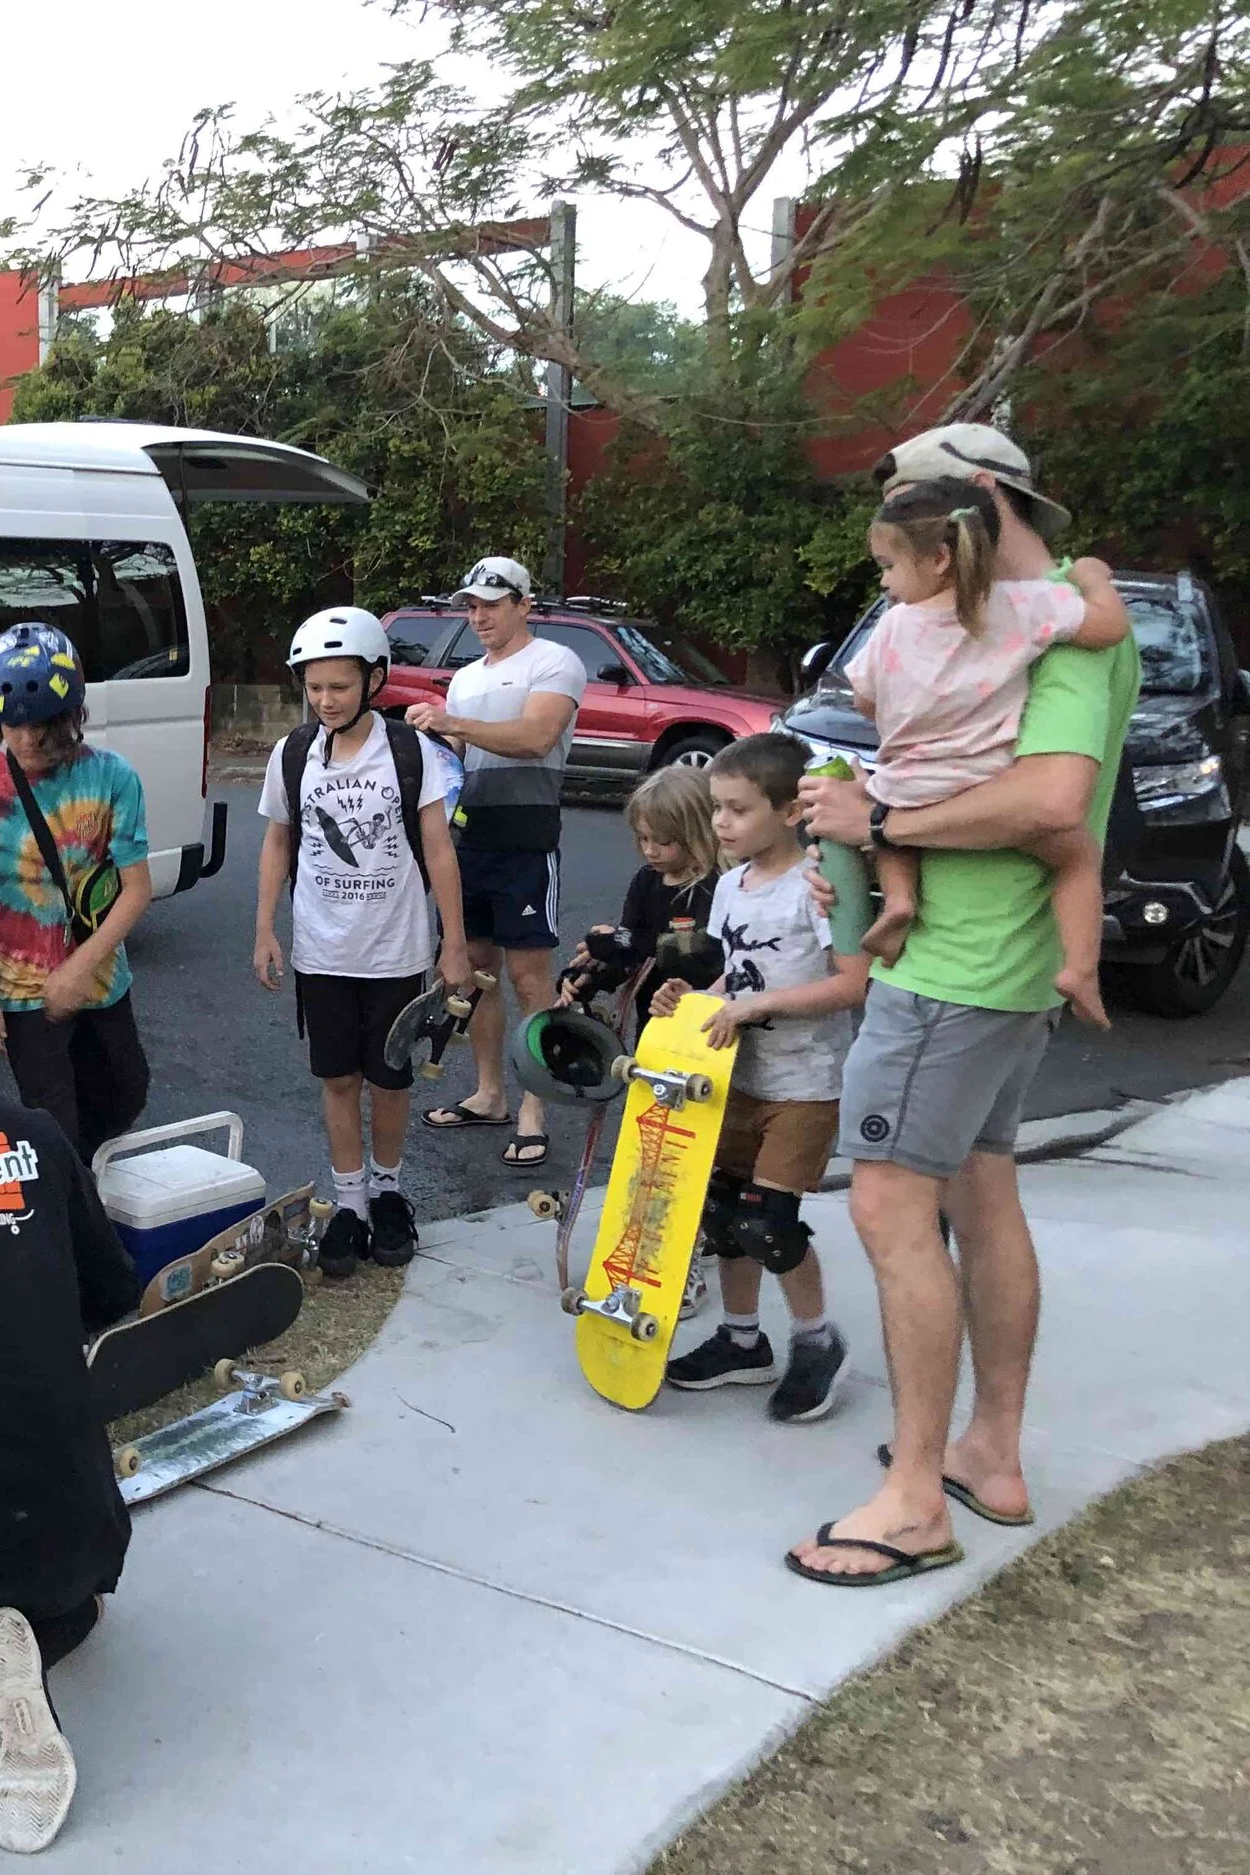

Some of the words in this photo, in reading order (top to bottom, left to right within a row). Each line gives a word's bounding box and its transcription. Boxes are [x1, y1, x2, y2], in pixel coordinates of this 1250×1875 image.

[304, 778, 377, 826] STRALIAN
[315, 876, 331, 887] OF
[334, 878, 396, 890] SURFING
[341, 892, 365, 901] 2016
